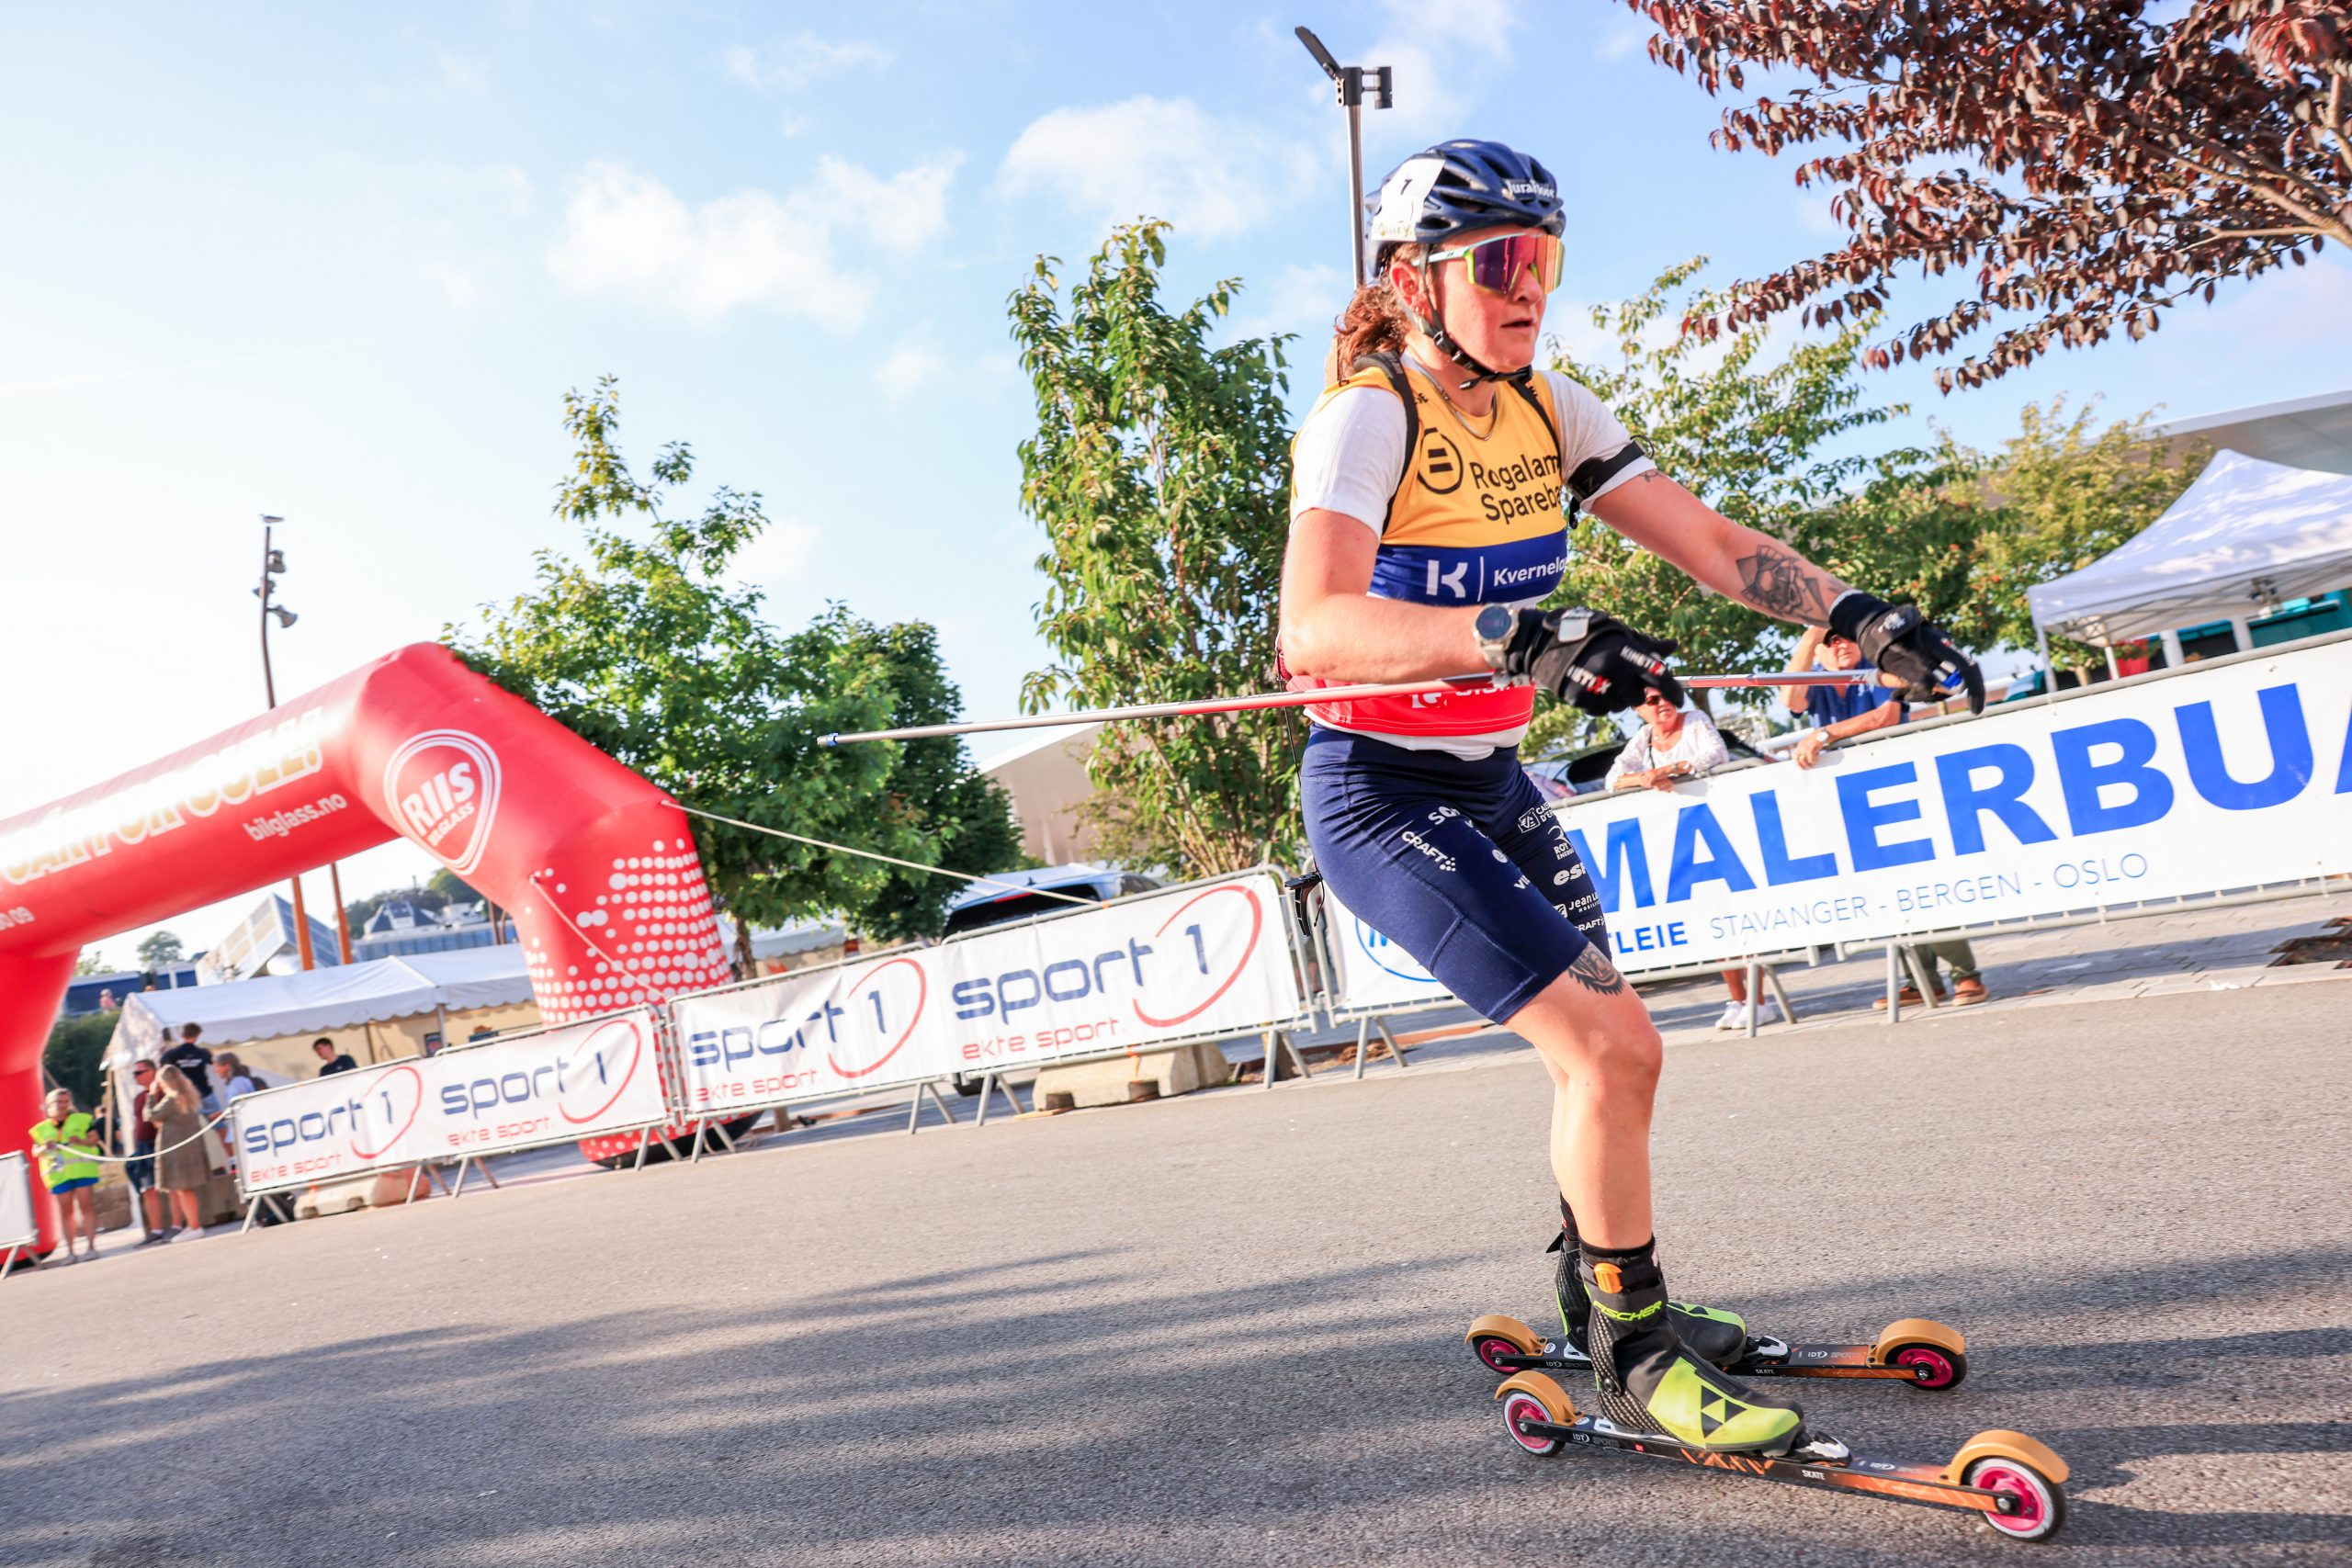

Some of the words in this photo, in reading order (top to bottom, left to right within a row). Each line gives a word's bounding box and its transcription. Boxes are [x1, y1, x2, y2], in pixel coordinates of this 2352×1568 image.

[401, 761, 476, 837] RIIS
[1566, 682, 2352, 913] MALERBU
[243, 794, 347, 841] bilglass.no
[1401, 830, 1449, 863] CRAFT
[1554, 842, 1569, 854] ROY
[1710, 896, 1867, 940] STAVANGER
[1897, 872, 2022, 913] BERGEN
[2053, 852, 2148, 889] OSLO
[1574, 919, 1601, 931] RAFT
[1609, 921, 1689, 954] LEIE
[952, 937, 1154, 1026] sport
[1185, 924, 1209, 975] 1
[690, 1000, 845, 1072] sport
[868, 990, 887, 1034] 1
[962, 1035, 1026, 1061] ekte
[1036, 1017, 1119, 1051] sport
[441, 1056, 570, 1120] sport
[695, 1081, 745, 1101] ekte
[752, 1069, 818, 1096] sport
[244, 1098, 363, 1157] sport
[381, 1090, 393, 1124] 1
[447, 1127, 492, 1146] ekte
[496, 1116, 550, 1139] sport
[251, 1165, 288, 1183] ekte
[294, 1154, 343, 1175] sport
[1592, 1300, 1663, 1322] FISCHER
[1802, 1469, 1826, 1481] SKATE
